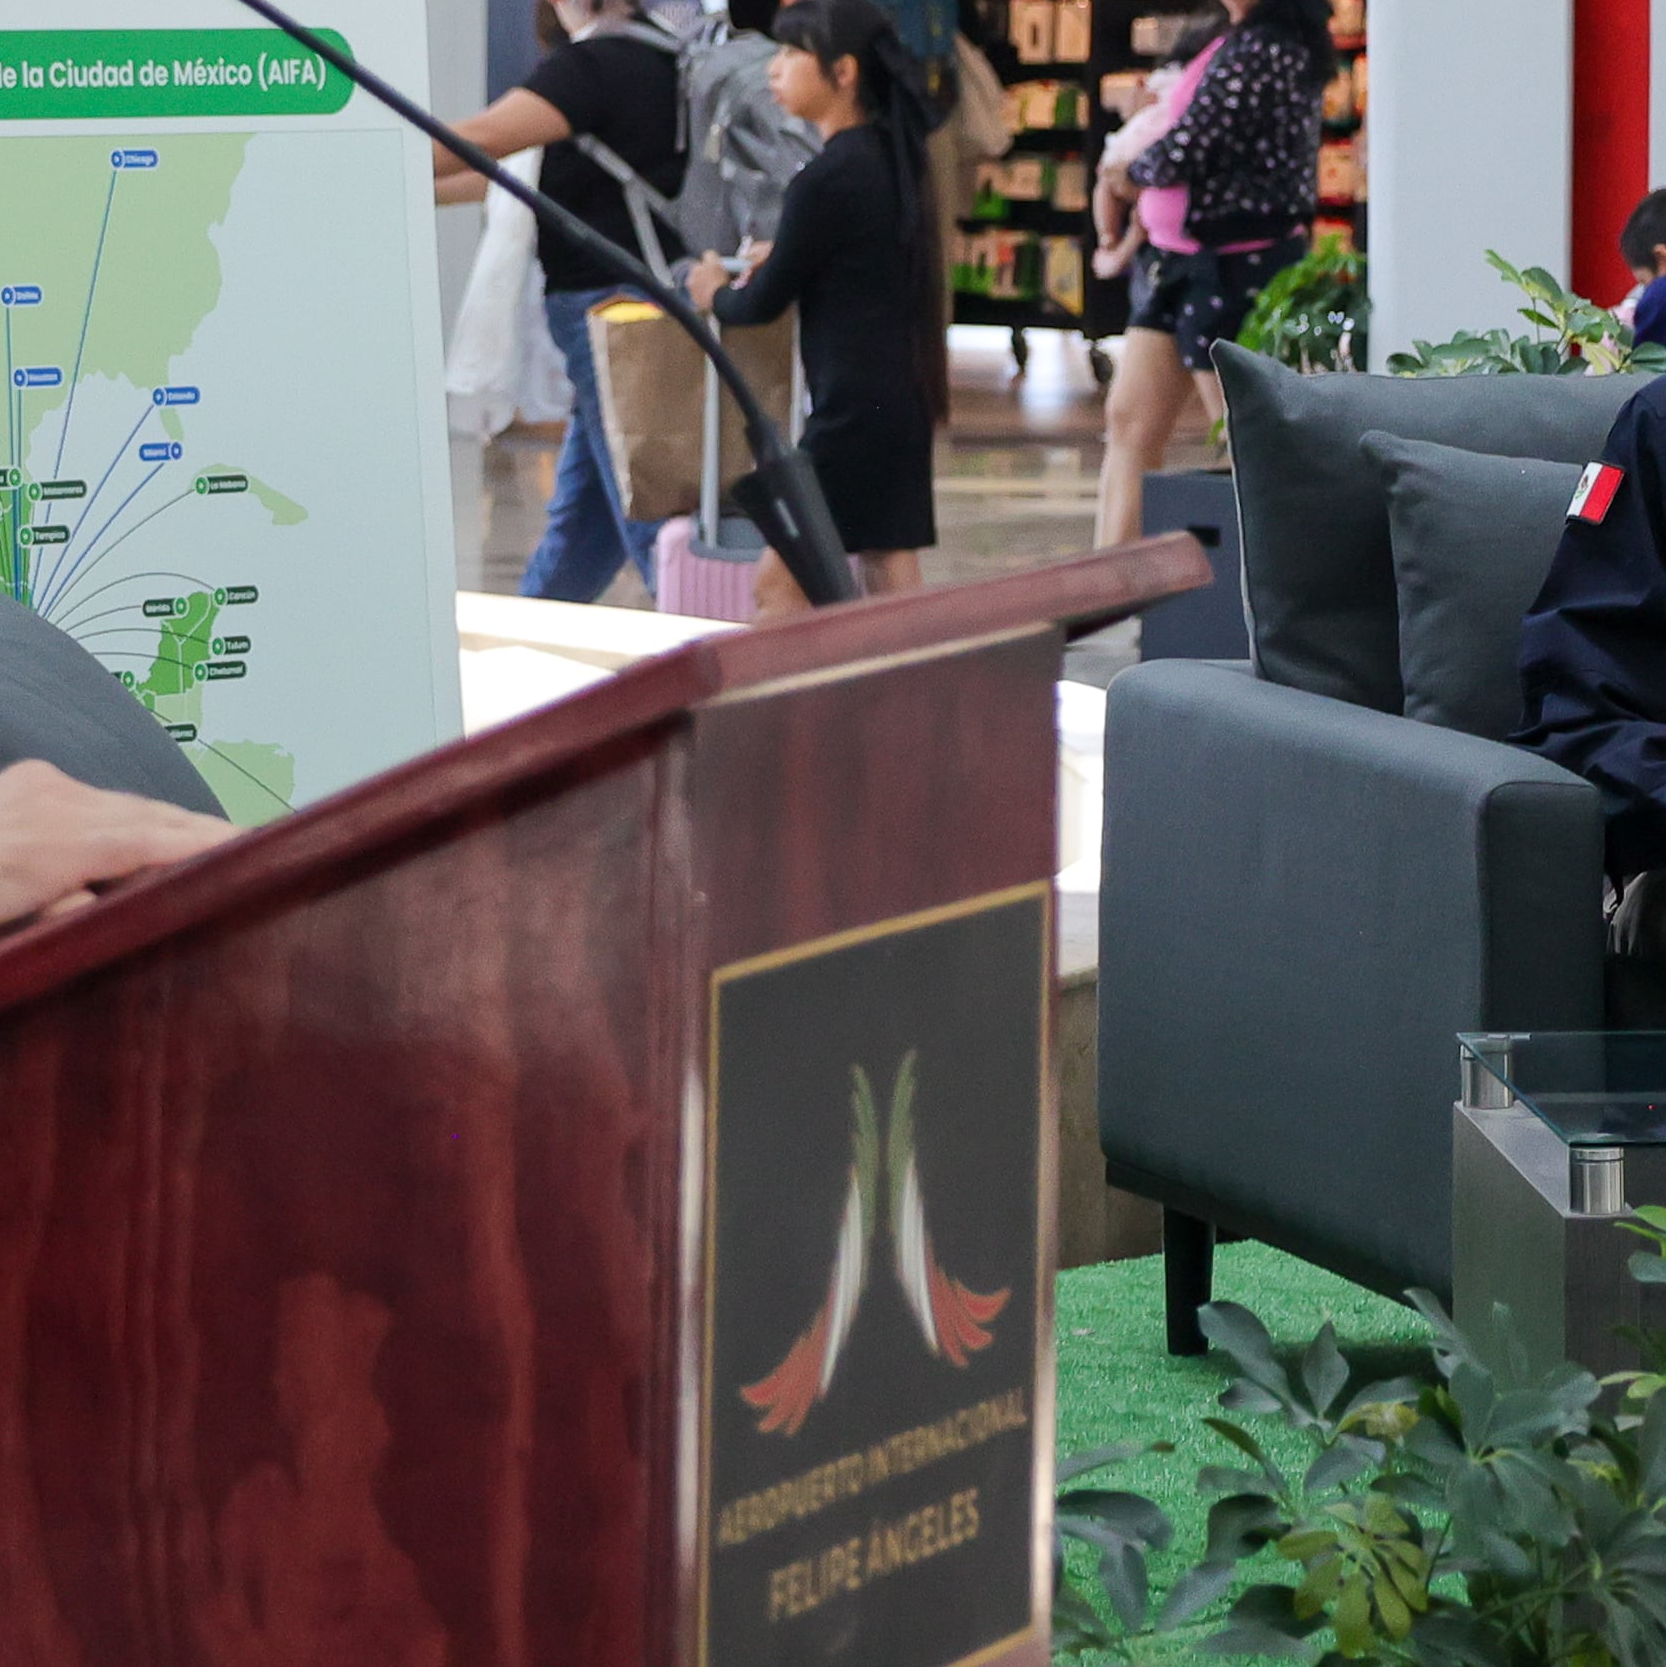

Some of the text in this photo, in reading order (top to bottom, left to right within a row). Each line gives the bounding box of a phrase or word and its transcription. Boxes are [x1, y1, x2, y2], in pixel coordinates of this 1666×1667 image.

[22, 60, 44, 89] la
[49, 58, 133, 89] Ciudad
[139, 57, 169, 87] de
[173, 55, 252, 86] México
[259, 52, 326, 90] (AIFA)
[717, 1386, 1028, 1546] AEROPUERTO INTERNACIONAL
[767, 1486, 981, 1624] FELIPE ÁNGELES
